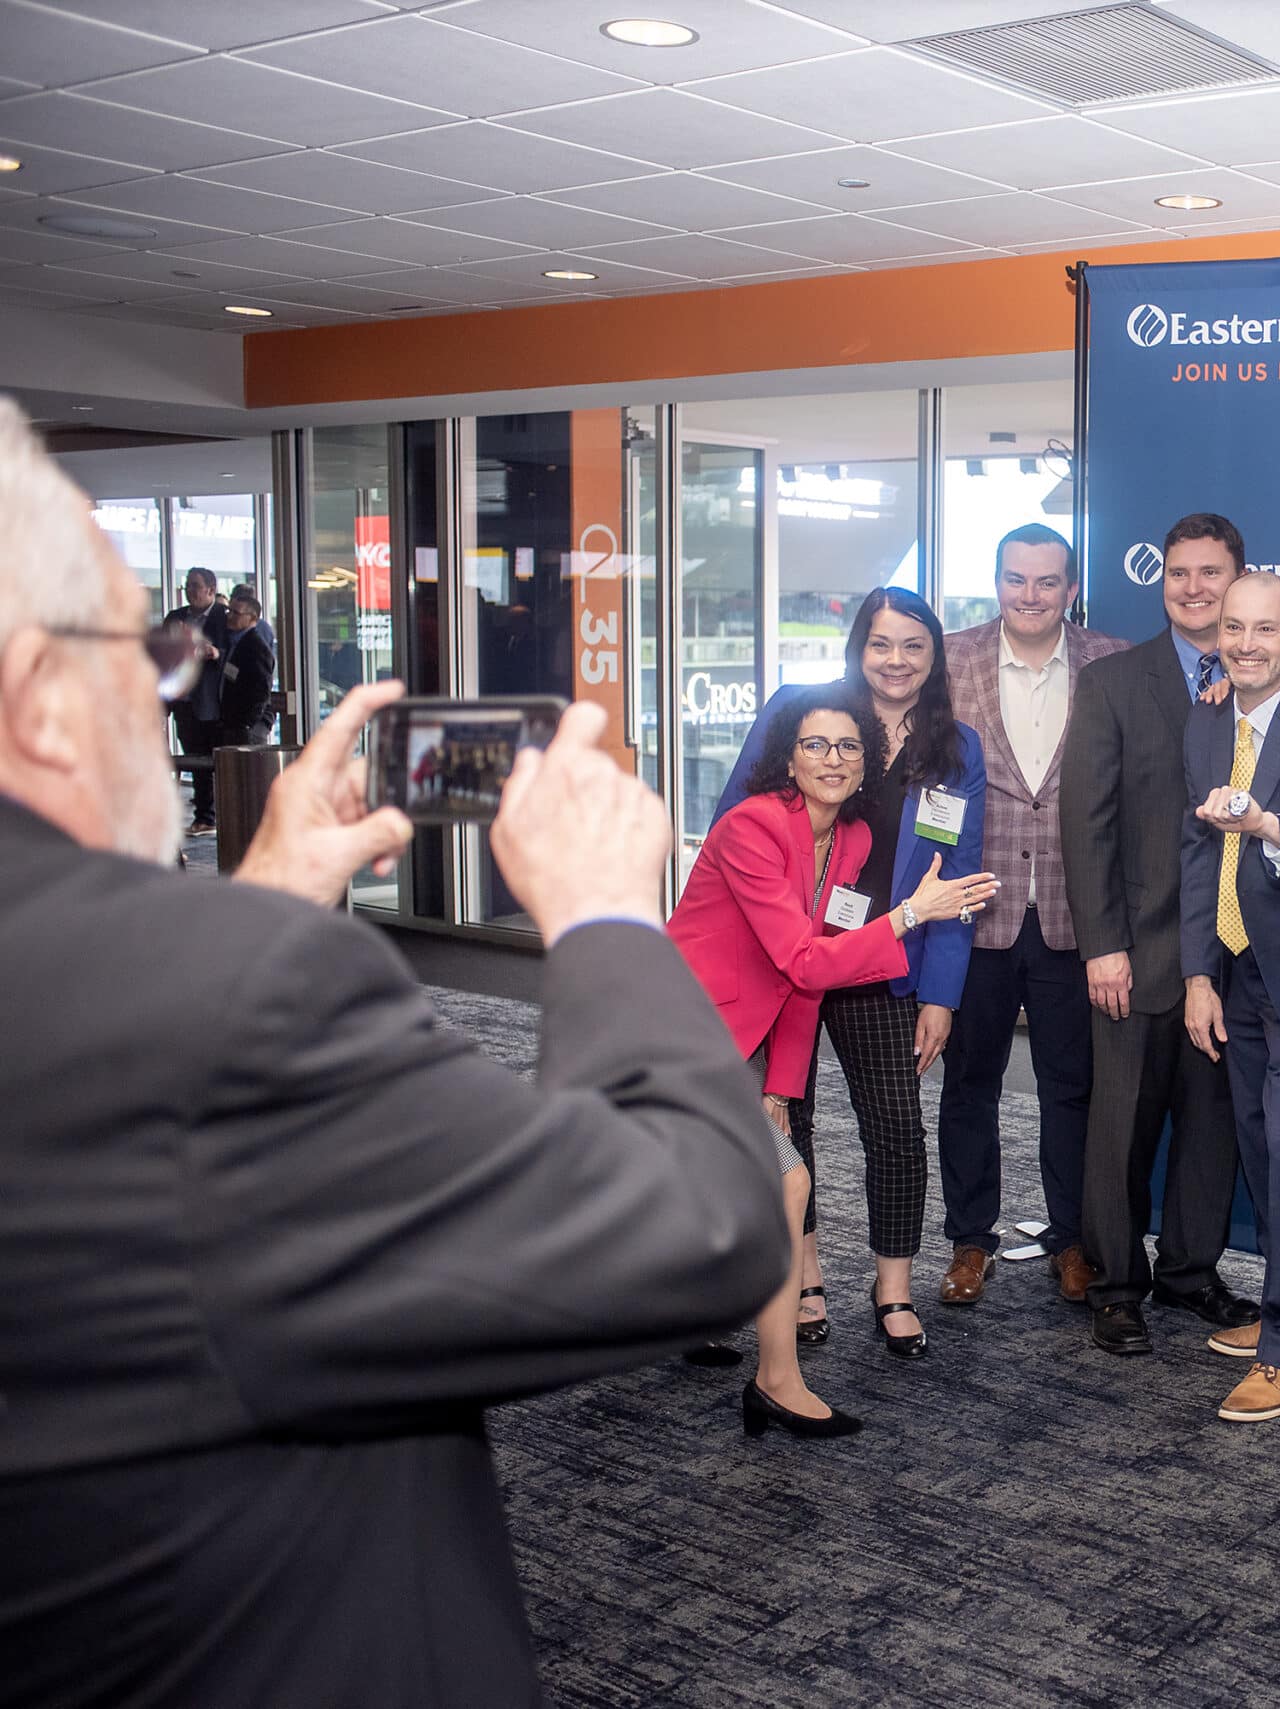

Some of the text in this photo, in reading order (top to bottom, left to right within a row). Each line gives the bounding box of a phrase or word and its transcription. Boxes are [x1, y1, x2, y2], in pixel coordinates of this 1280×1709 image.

[1173, 364, 1226, 382] JOIN
[1238, 363, 1267, 381] US
[580, 608, 617, 684] 35
